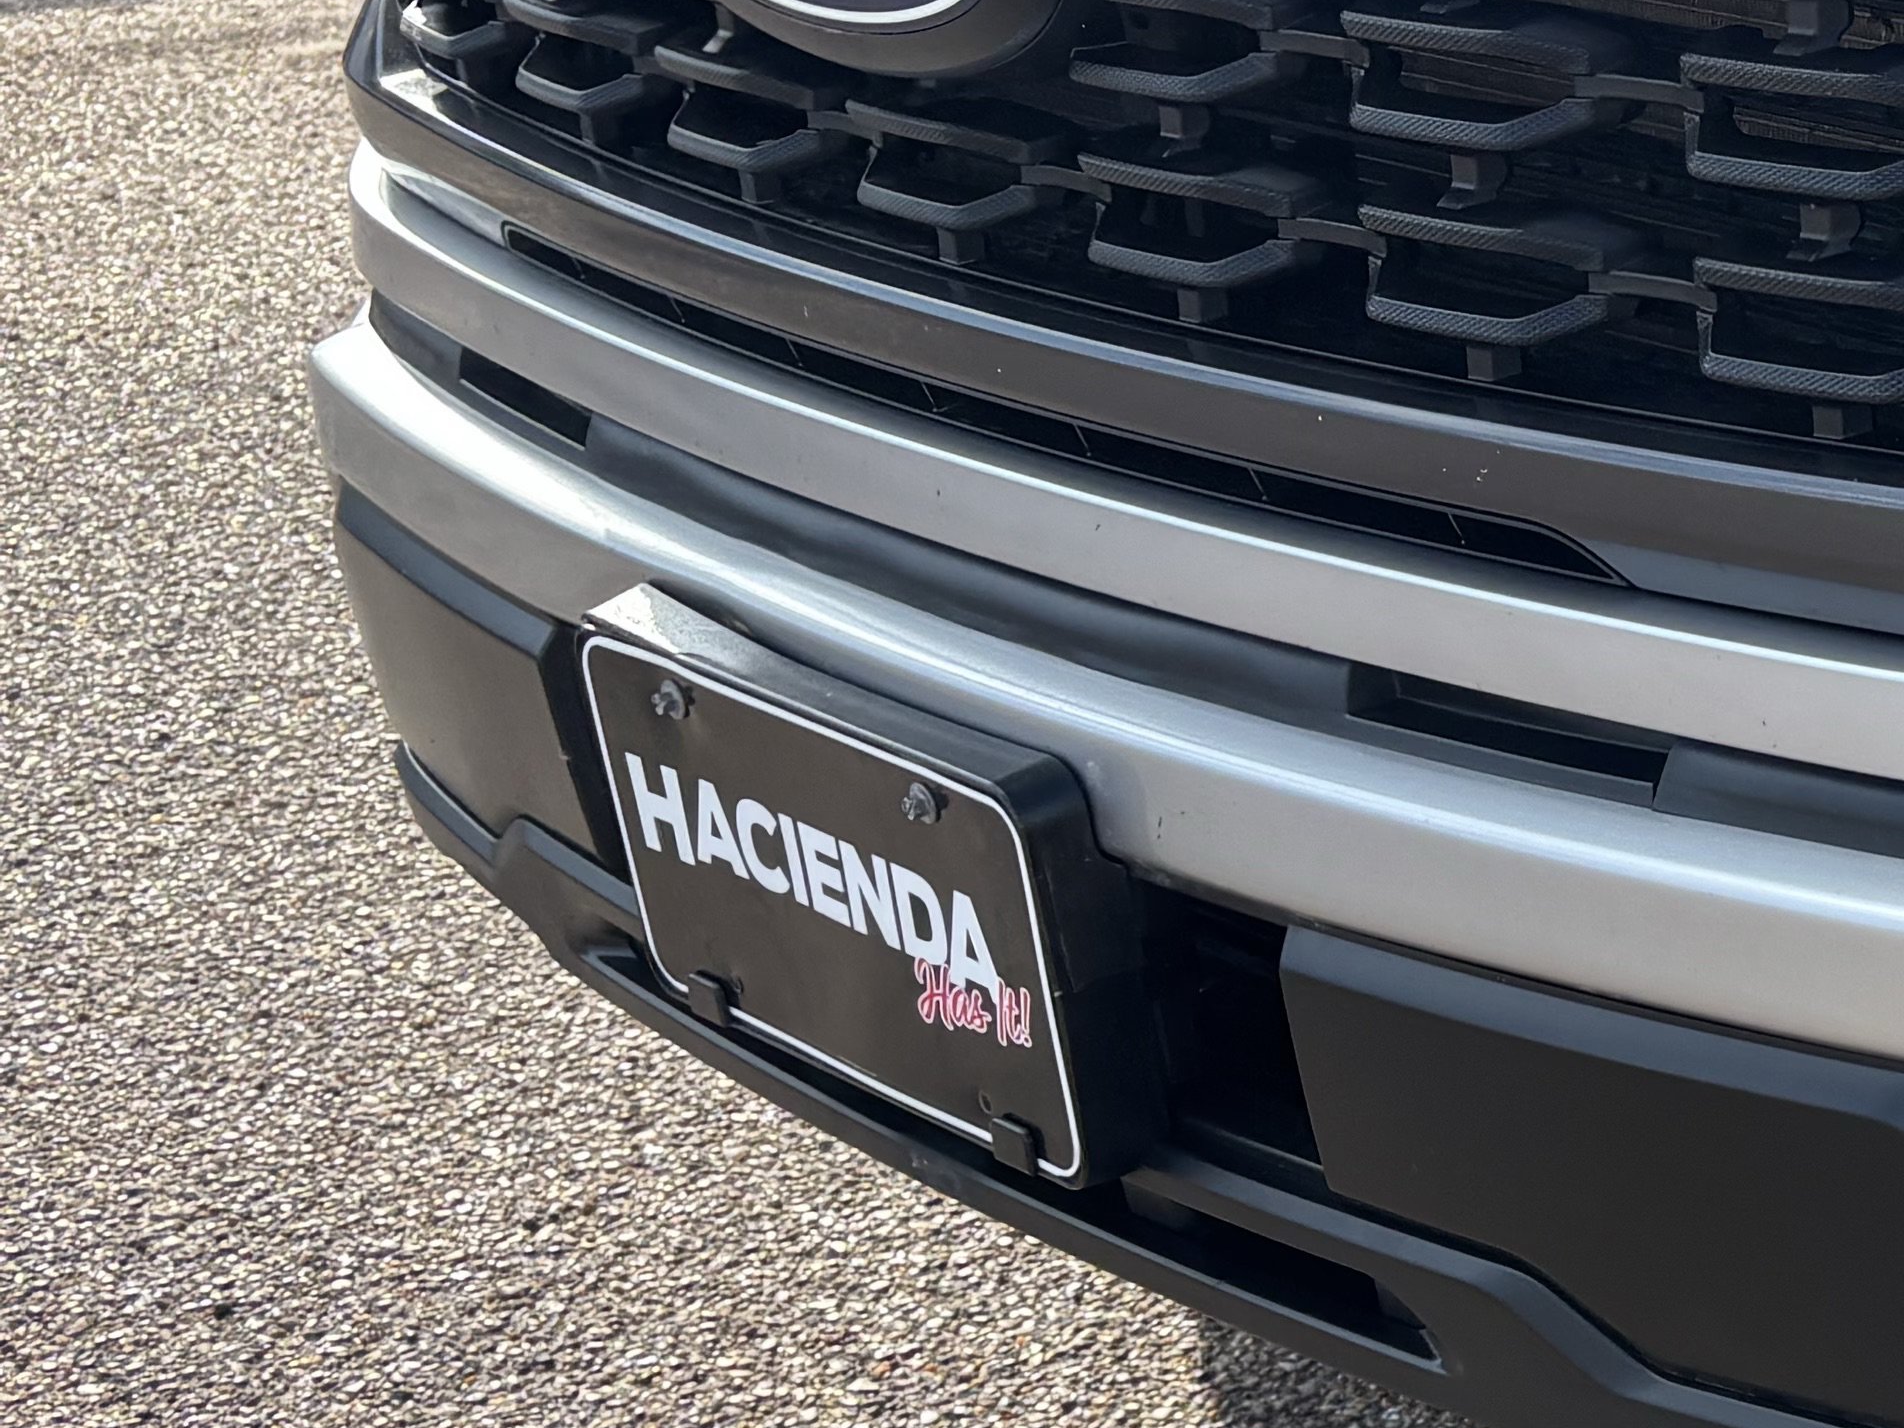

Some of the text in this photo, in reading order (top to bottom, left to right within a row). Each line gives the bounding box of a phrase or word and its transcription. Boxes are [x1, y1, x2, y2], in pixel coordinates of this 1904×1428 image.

[625, 752, 999, 1005] HACIENDA
[914, 957, 1032, 1048] Has It!
